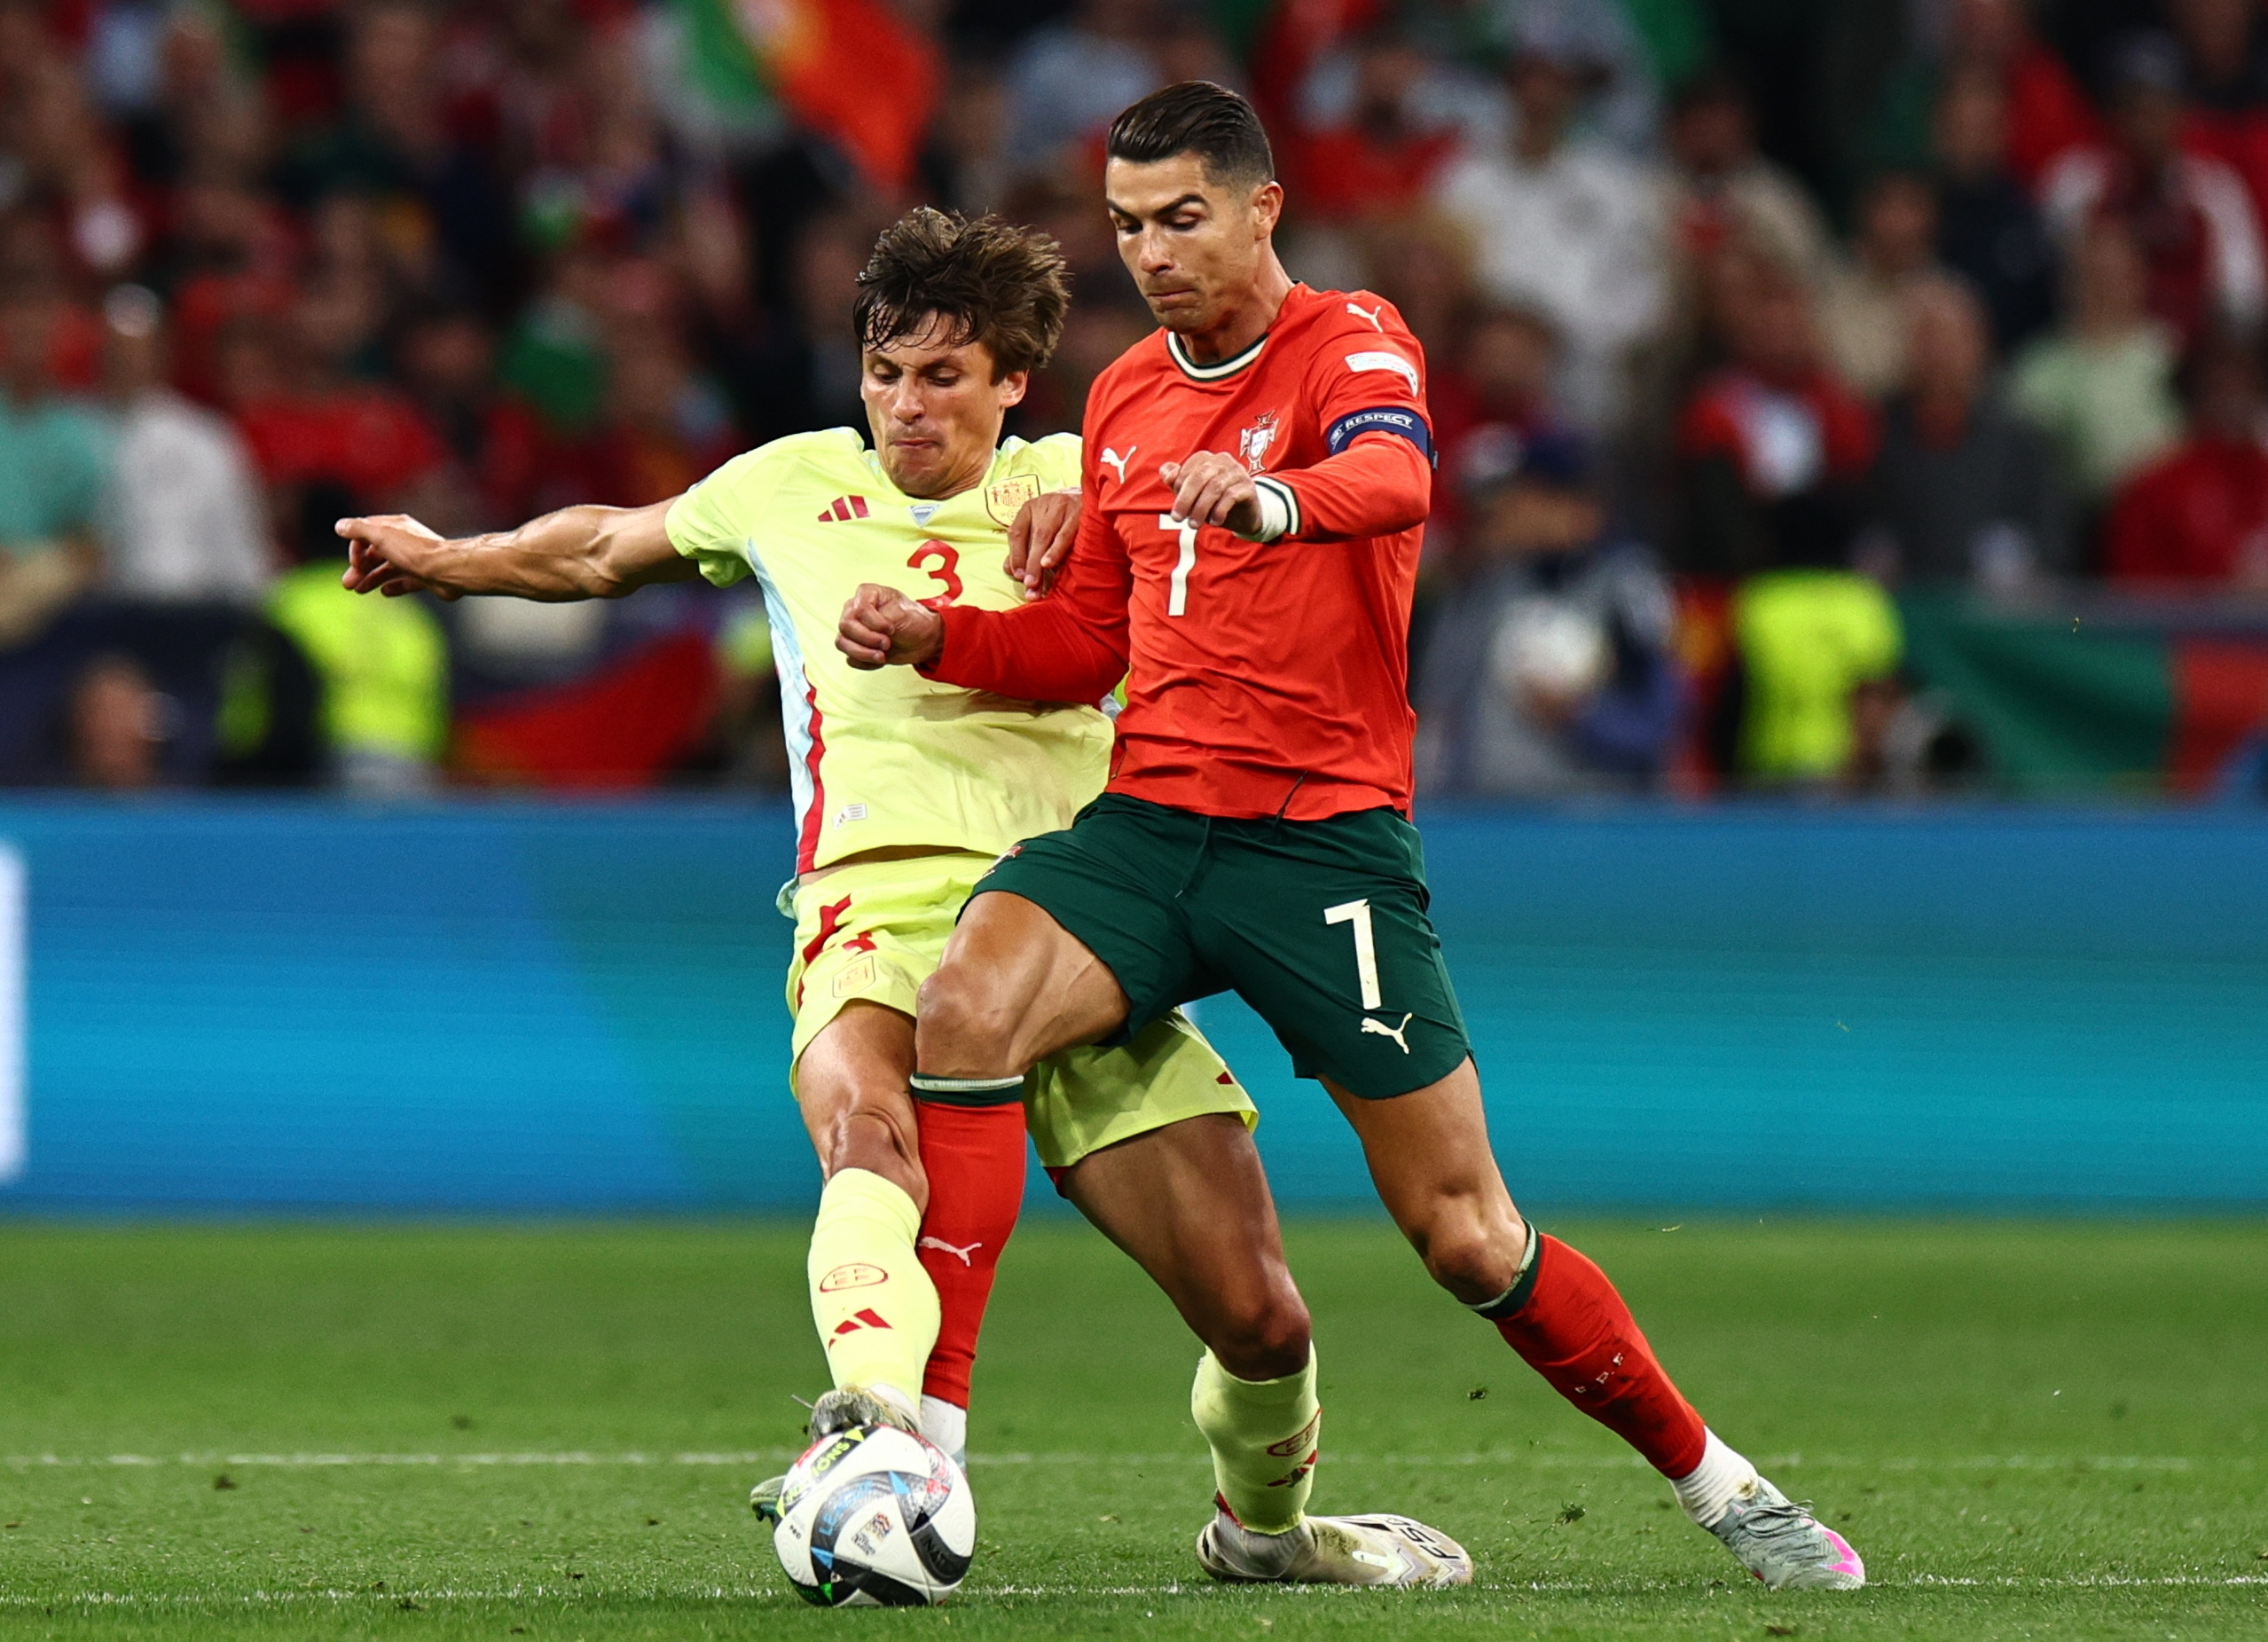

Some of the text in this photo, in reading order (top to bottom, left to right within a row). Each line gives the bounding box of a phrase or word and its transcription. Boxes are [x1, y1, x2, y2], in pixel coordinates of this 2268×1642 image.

[1345, 412, 1414, 429] RESPECT
[906, 538, 963, 609] 3
[1158, 514, 1197, 617] 7
[1323, 899, 1381, 1010] 7
